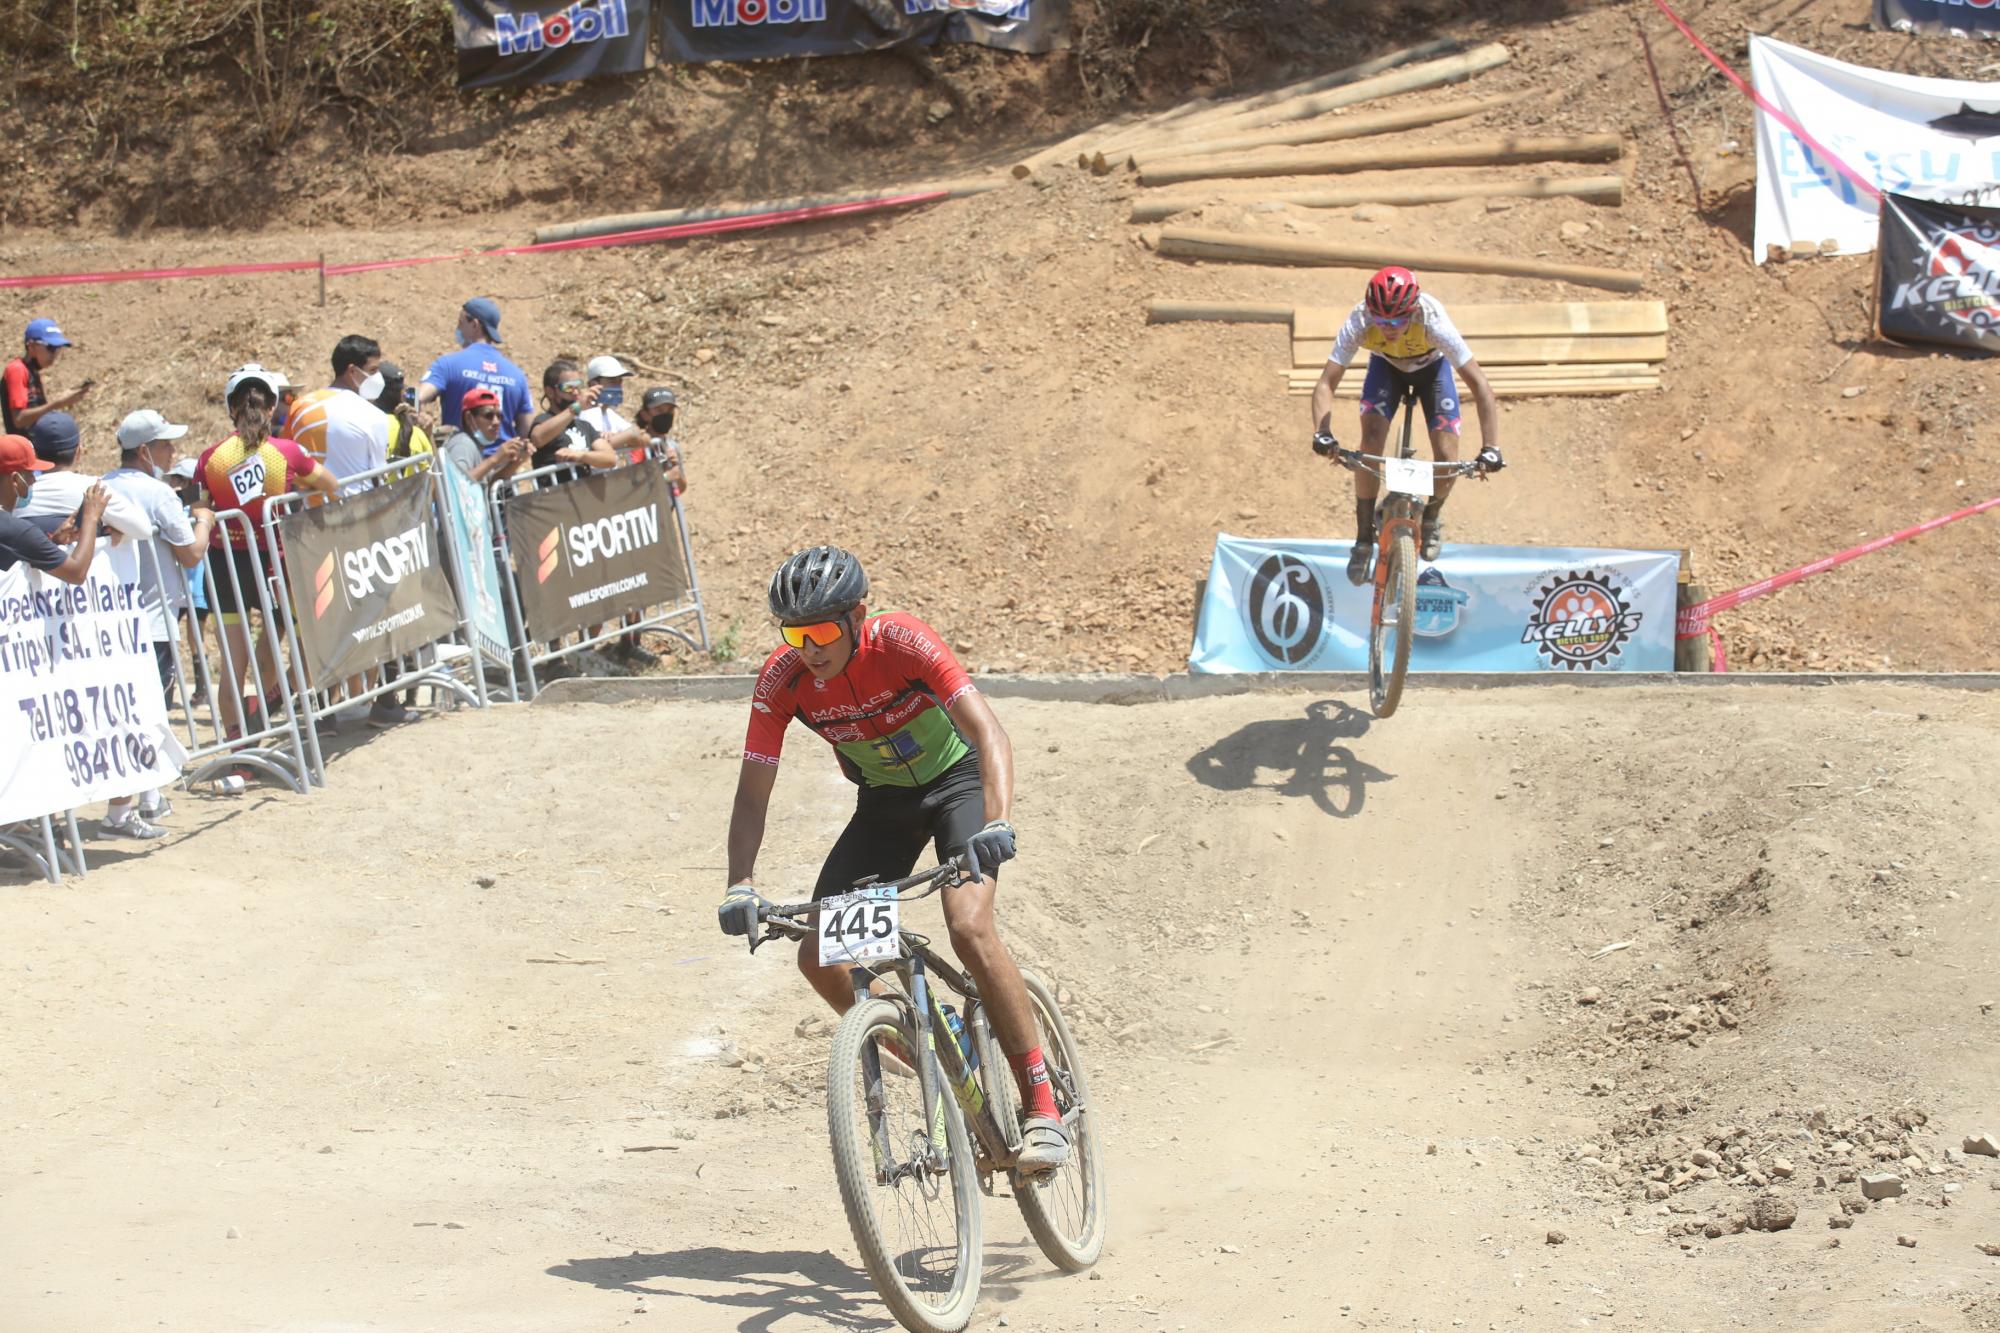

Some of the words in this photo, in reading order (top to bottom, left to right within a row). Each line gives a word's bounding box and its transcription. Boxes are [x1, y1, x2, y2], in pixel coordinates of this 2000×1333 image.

[494, 0, 629, 56] Mobil
[234, 463, 265, 495] 620
[1521, 613, 1643, 644] KELLY'S
[1556, 635, 1587, 646] BICYCLE
[824, 905, 893, 943] 445
